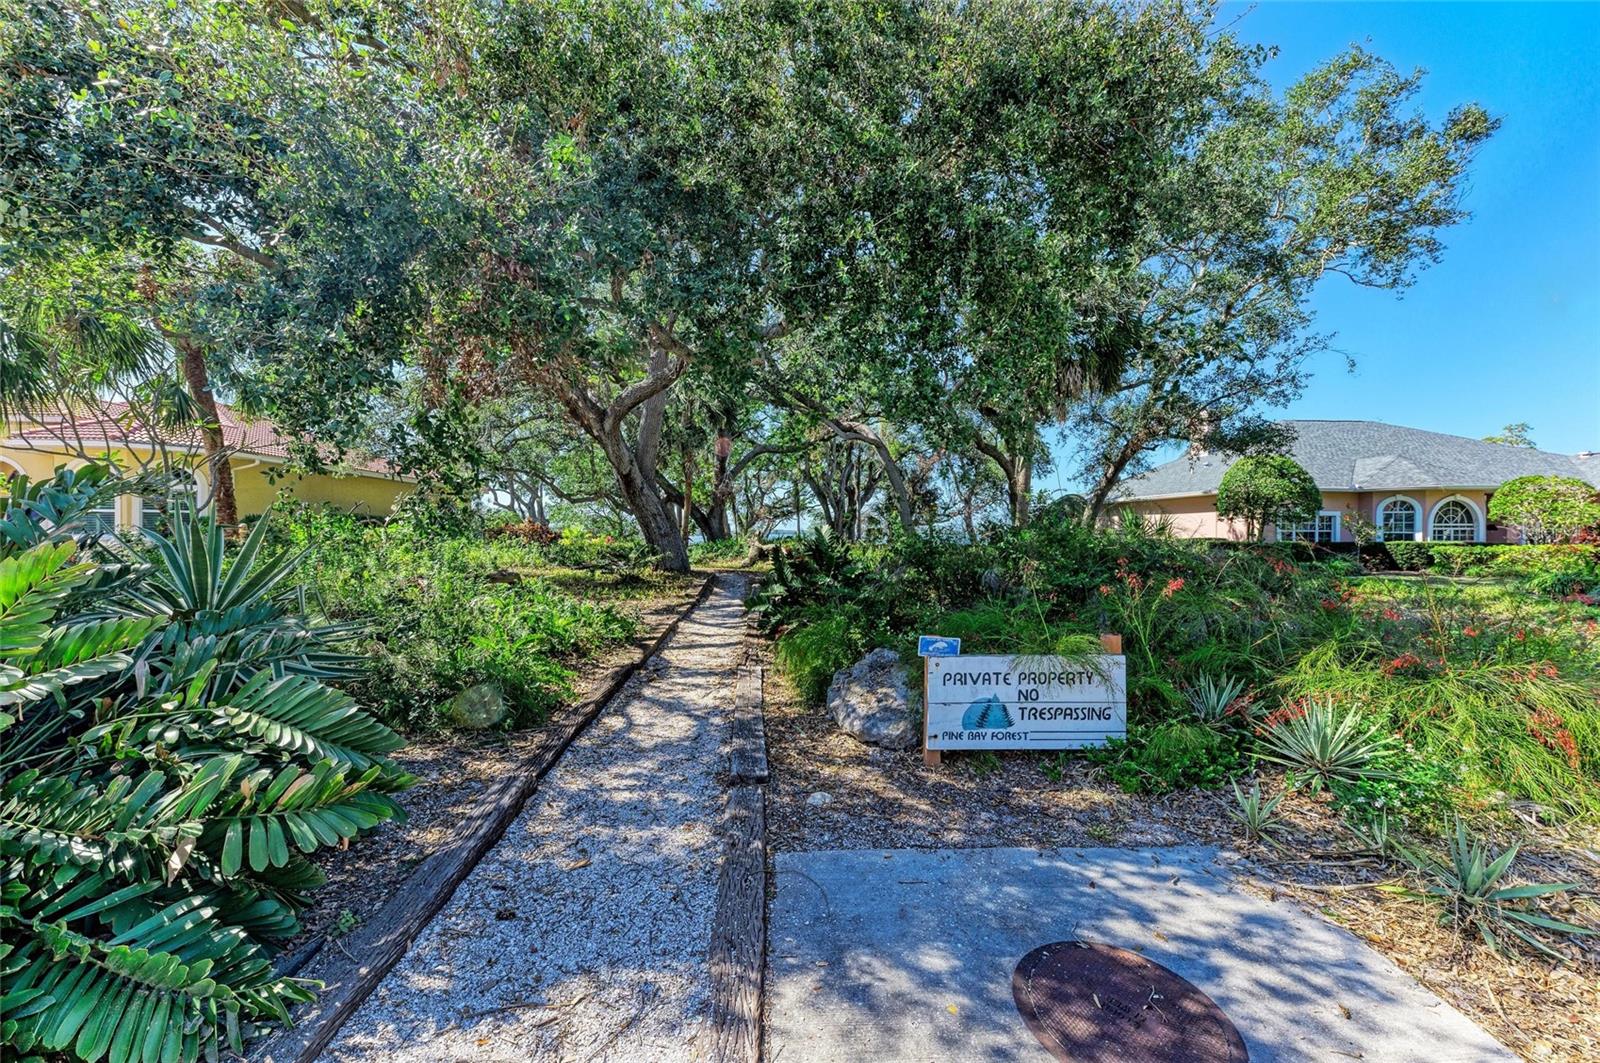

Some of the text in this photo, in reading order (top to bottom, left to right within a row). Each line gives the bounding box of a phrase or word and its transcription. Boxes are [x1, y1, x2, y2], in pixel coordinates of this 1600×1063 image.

[943, 671, 1093, 686] PRIVATE PROPERTY
[1017, 688, 1039, 702] NO
[1018, 706, 1112, 721] TRESPASSING
[942, 731, 1029, 741] PINE BAY FOREST
